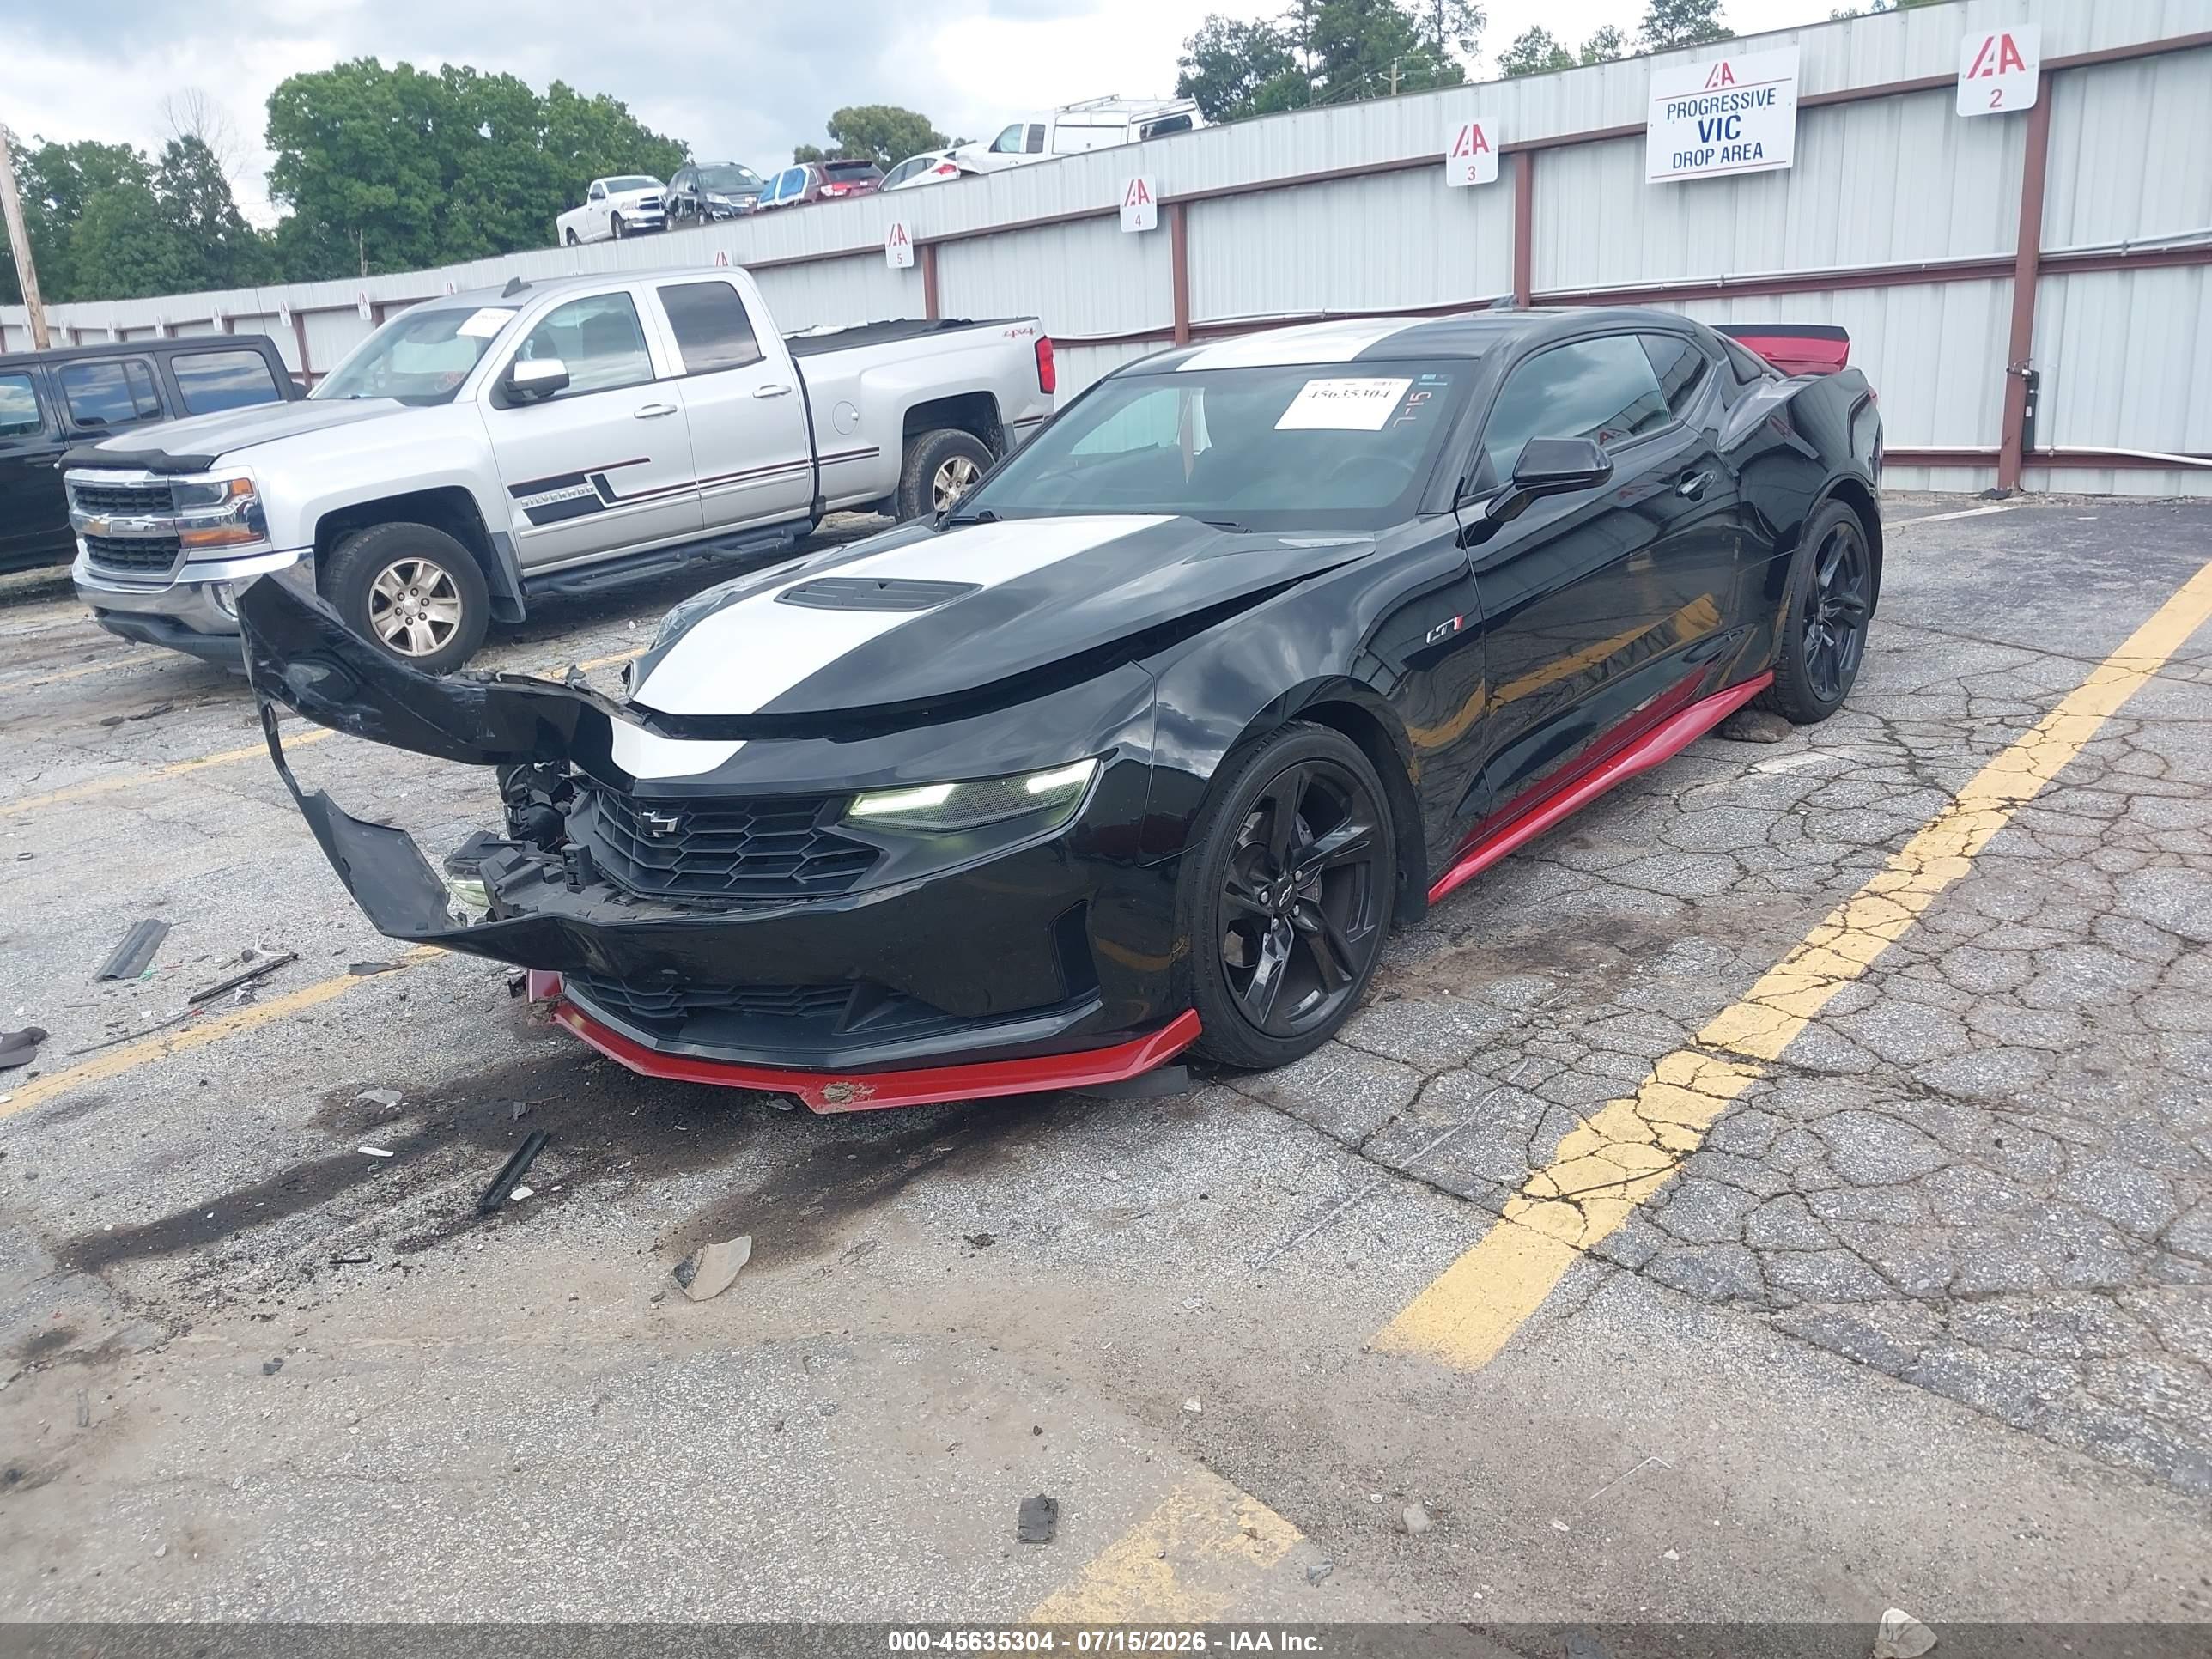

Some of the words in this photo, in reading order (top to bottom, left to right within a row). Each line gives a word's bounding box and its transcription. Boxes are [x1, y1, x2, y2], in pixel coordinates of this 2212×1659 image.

[1667, 88, 1777, 120] PROGRESSIVE
[1989, 88, 2002, 108] 2
[1698, 114, 1741, 143] VIC
[1673, 148, 1715, 169] DROP
[1720, 142, 1764, 163] AREA
[1468, 165, 1476, 181] 3
[1135, 213, 1142, 228] 4
[896, 253, 902, 264] 5
[520, 485, 595, 507] SILVERADO
[1425, 613, 1464, 645] LT1
